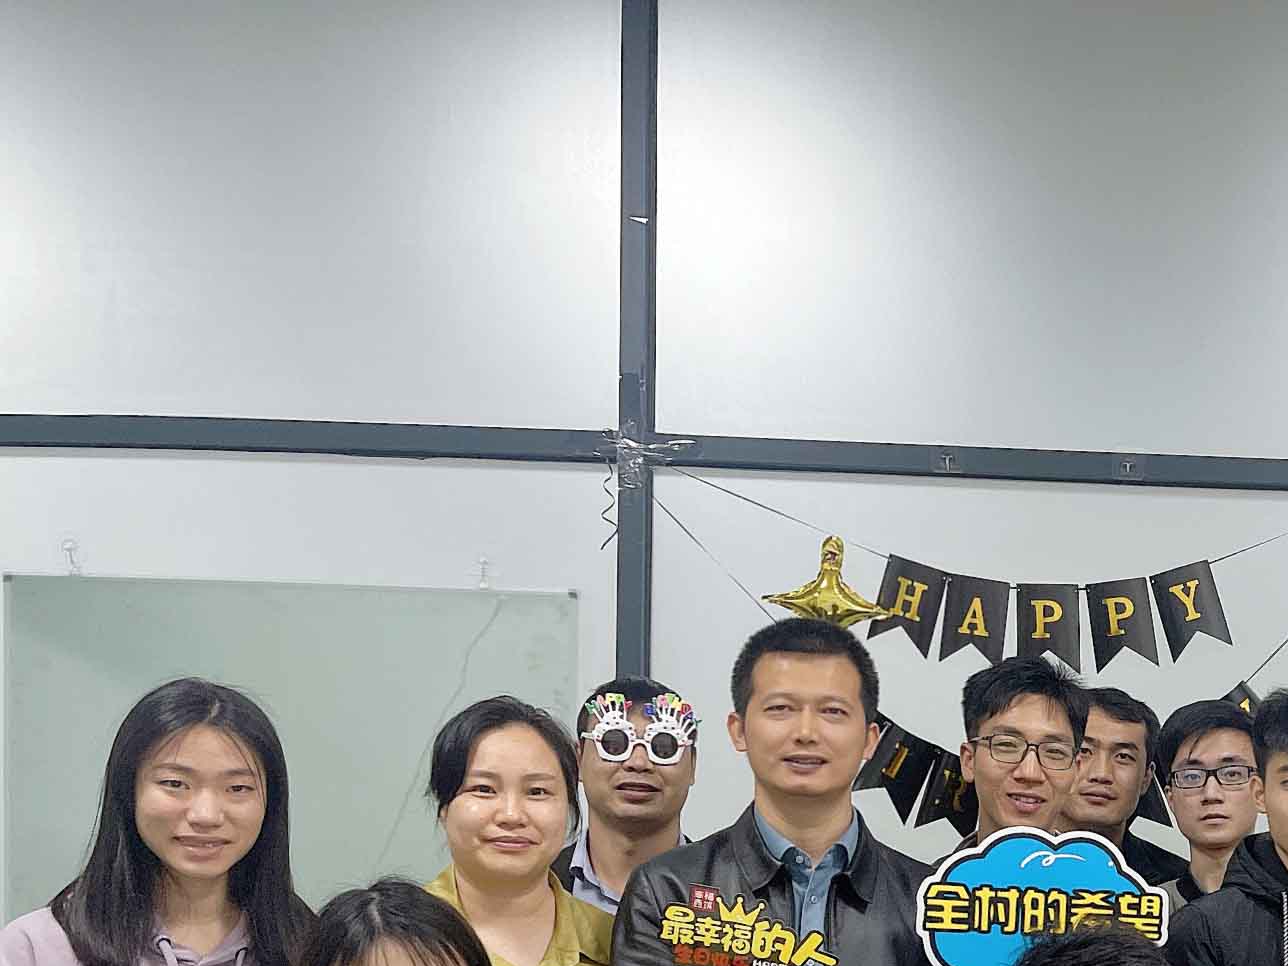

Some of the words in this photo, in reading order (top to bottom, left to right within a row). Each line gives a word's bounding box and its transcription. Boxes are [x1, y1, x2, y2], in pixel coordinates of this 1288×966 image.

[889, 576, 1204, 640] HAPPY
[660, 905, 837, 966] 最幸福的人
[926, 885, 1160, 939] 全村的希望
